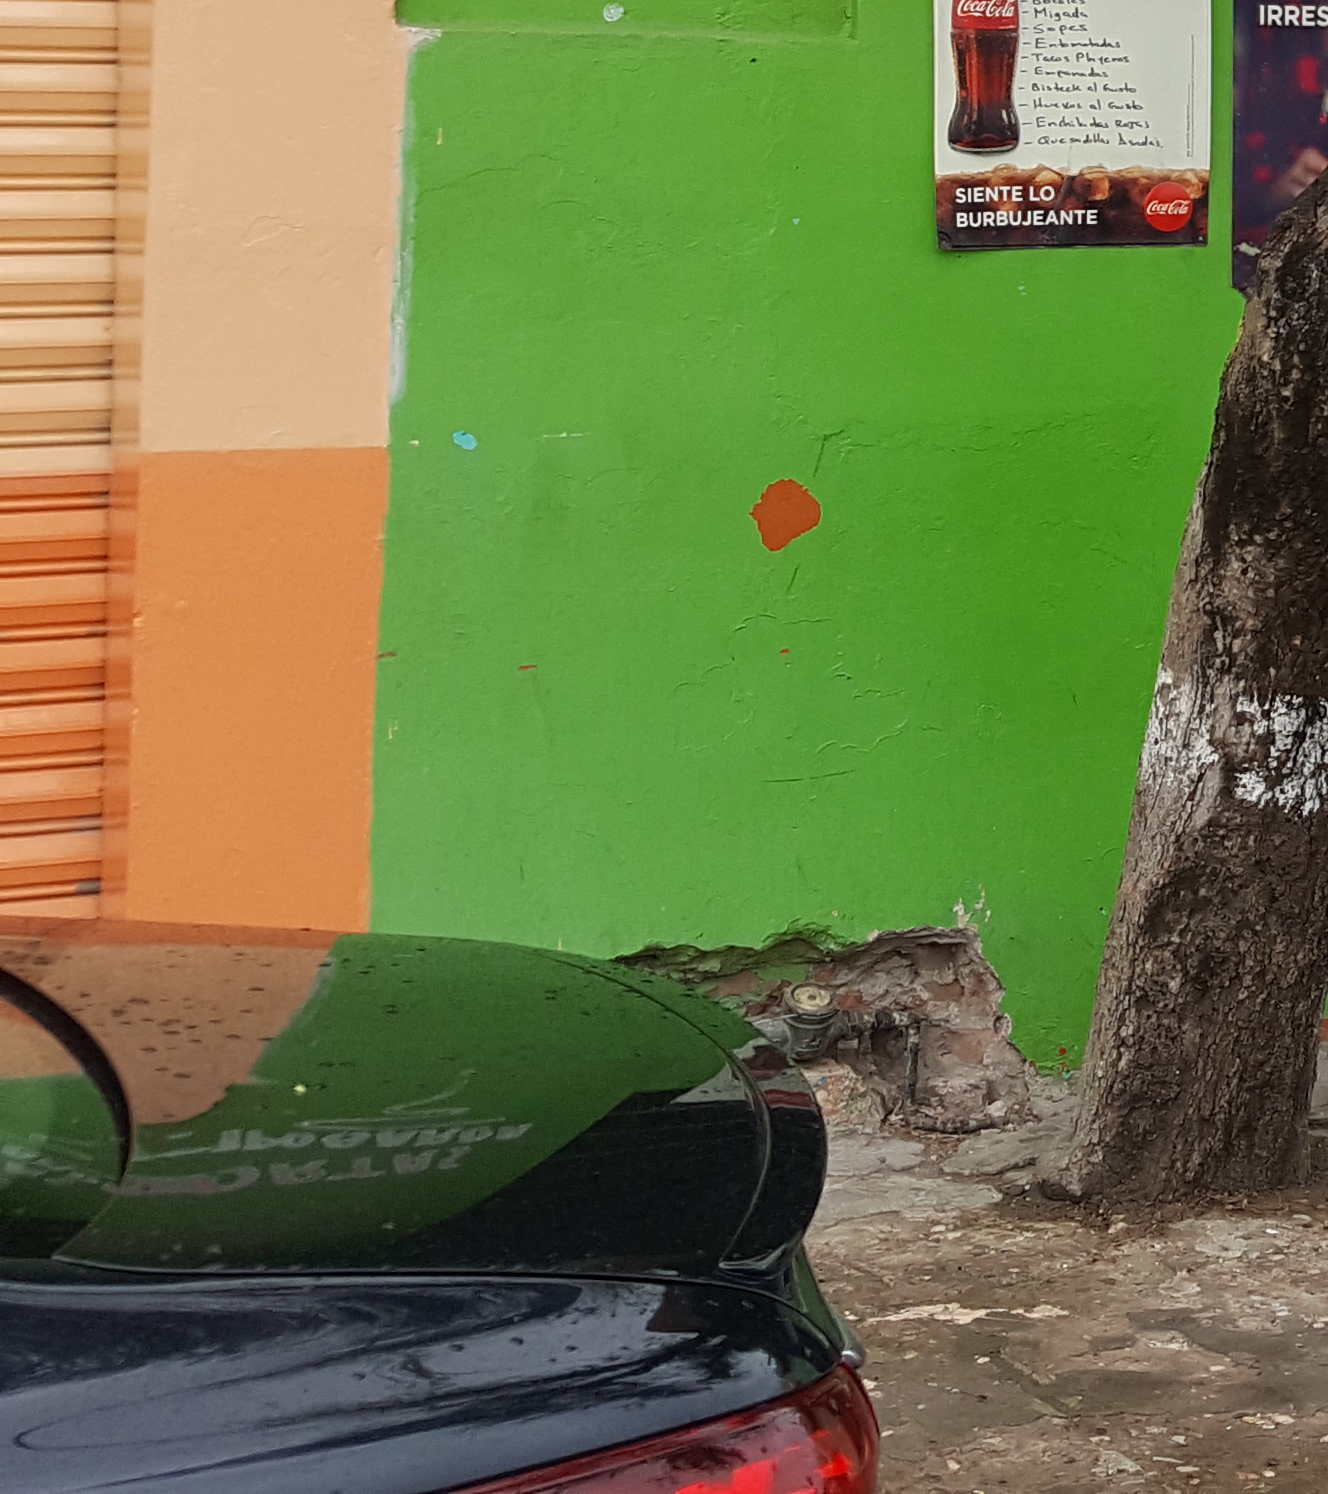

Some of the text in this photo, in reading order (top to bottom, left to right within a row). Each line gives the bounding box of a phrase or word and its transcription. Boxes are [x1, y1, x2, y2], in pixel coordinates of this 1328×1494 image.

[1034, 7, 1088, 22] Migada
[1033, 23, 1088, 35] Sopes
[955, 186, 1056, 203] SIENTE LO
[1146, 199, 1191, 215] Coca-Cola
[956, 209, 1099, 228] BURBUJEANTE
